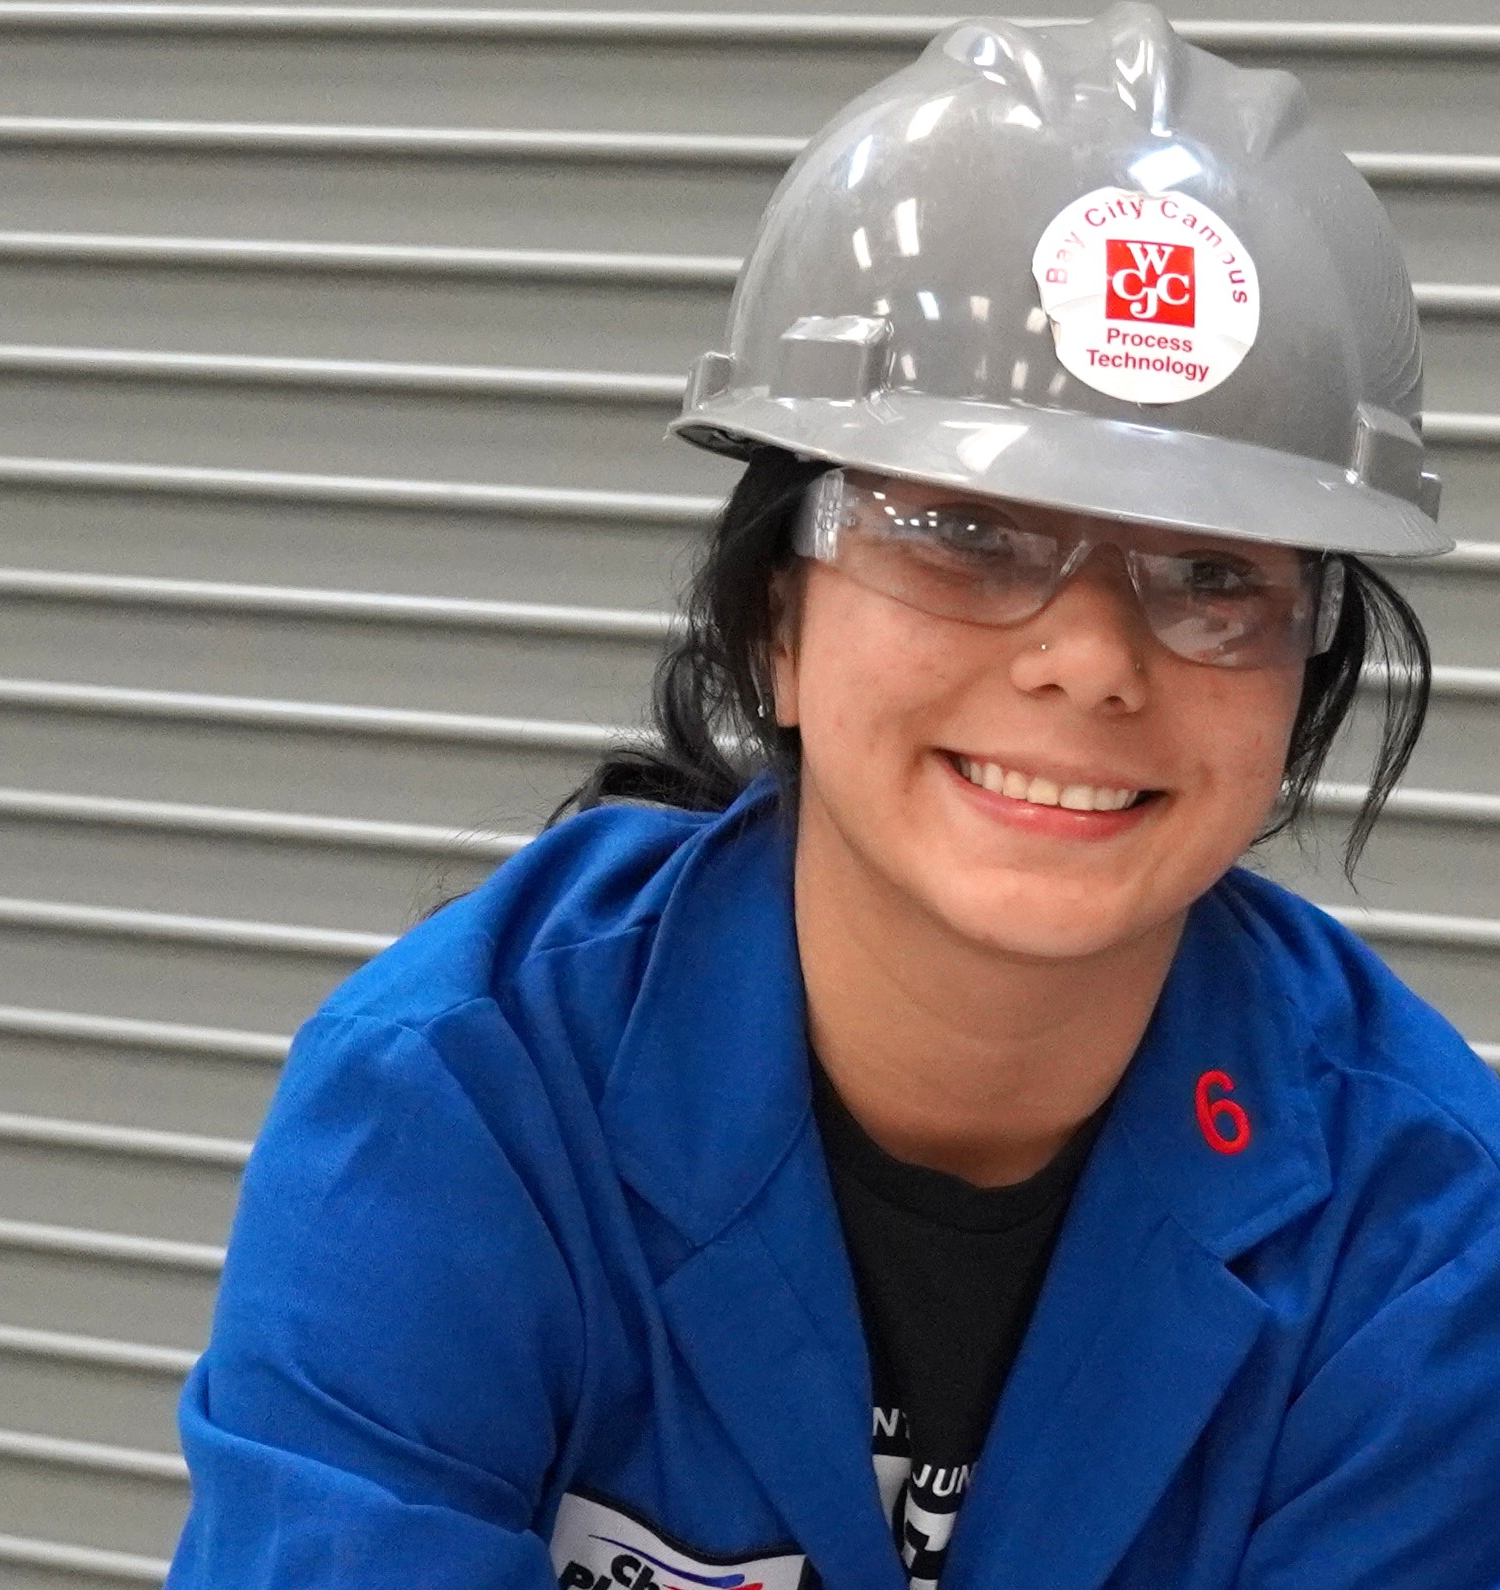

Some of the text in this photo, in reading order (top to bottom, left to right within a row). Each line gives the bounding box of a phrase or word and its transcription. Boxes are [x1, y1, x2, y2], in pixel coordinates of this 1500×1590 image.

[1045, 198, 1249, 304] Bay City Campus
[1086, 348, 1210, 382] Technology
[1106, 327, 1193, 352] Process
[1195, 1069, 1251, 1155] 6
